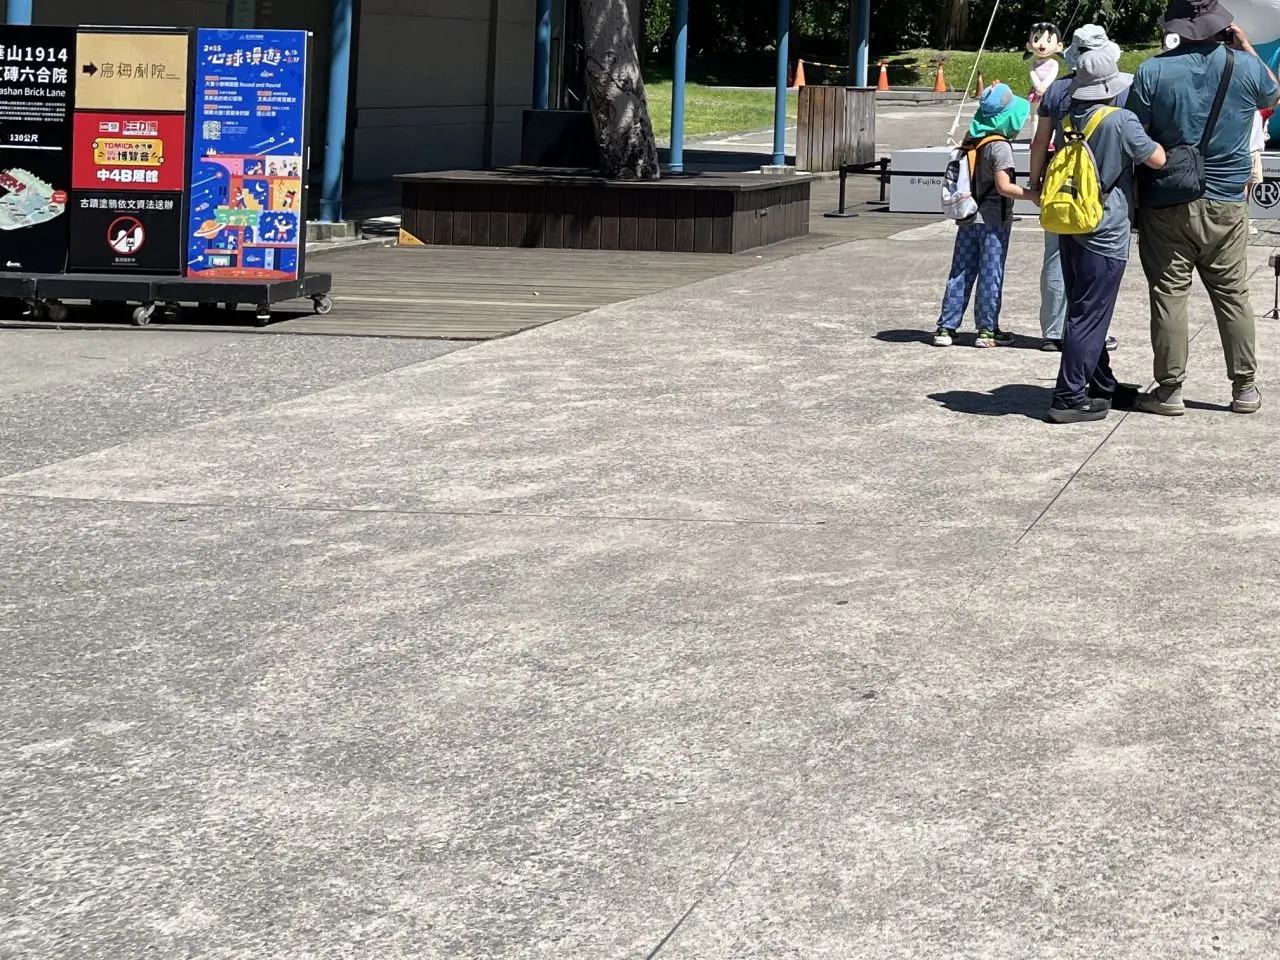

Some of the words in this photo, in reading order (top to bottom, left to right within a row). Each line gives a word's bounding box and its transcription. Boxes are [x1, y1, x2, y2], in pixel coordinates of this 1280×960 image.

[0, 66, 68, 84] 磚六合院
[24, 87, 45, 97] Brick
[46, 88, 66, 98] Lane
[104, 142, 134, 150] TOMICA
